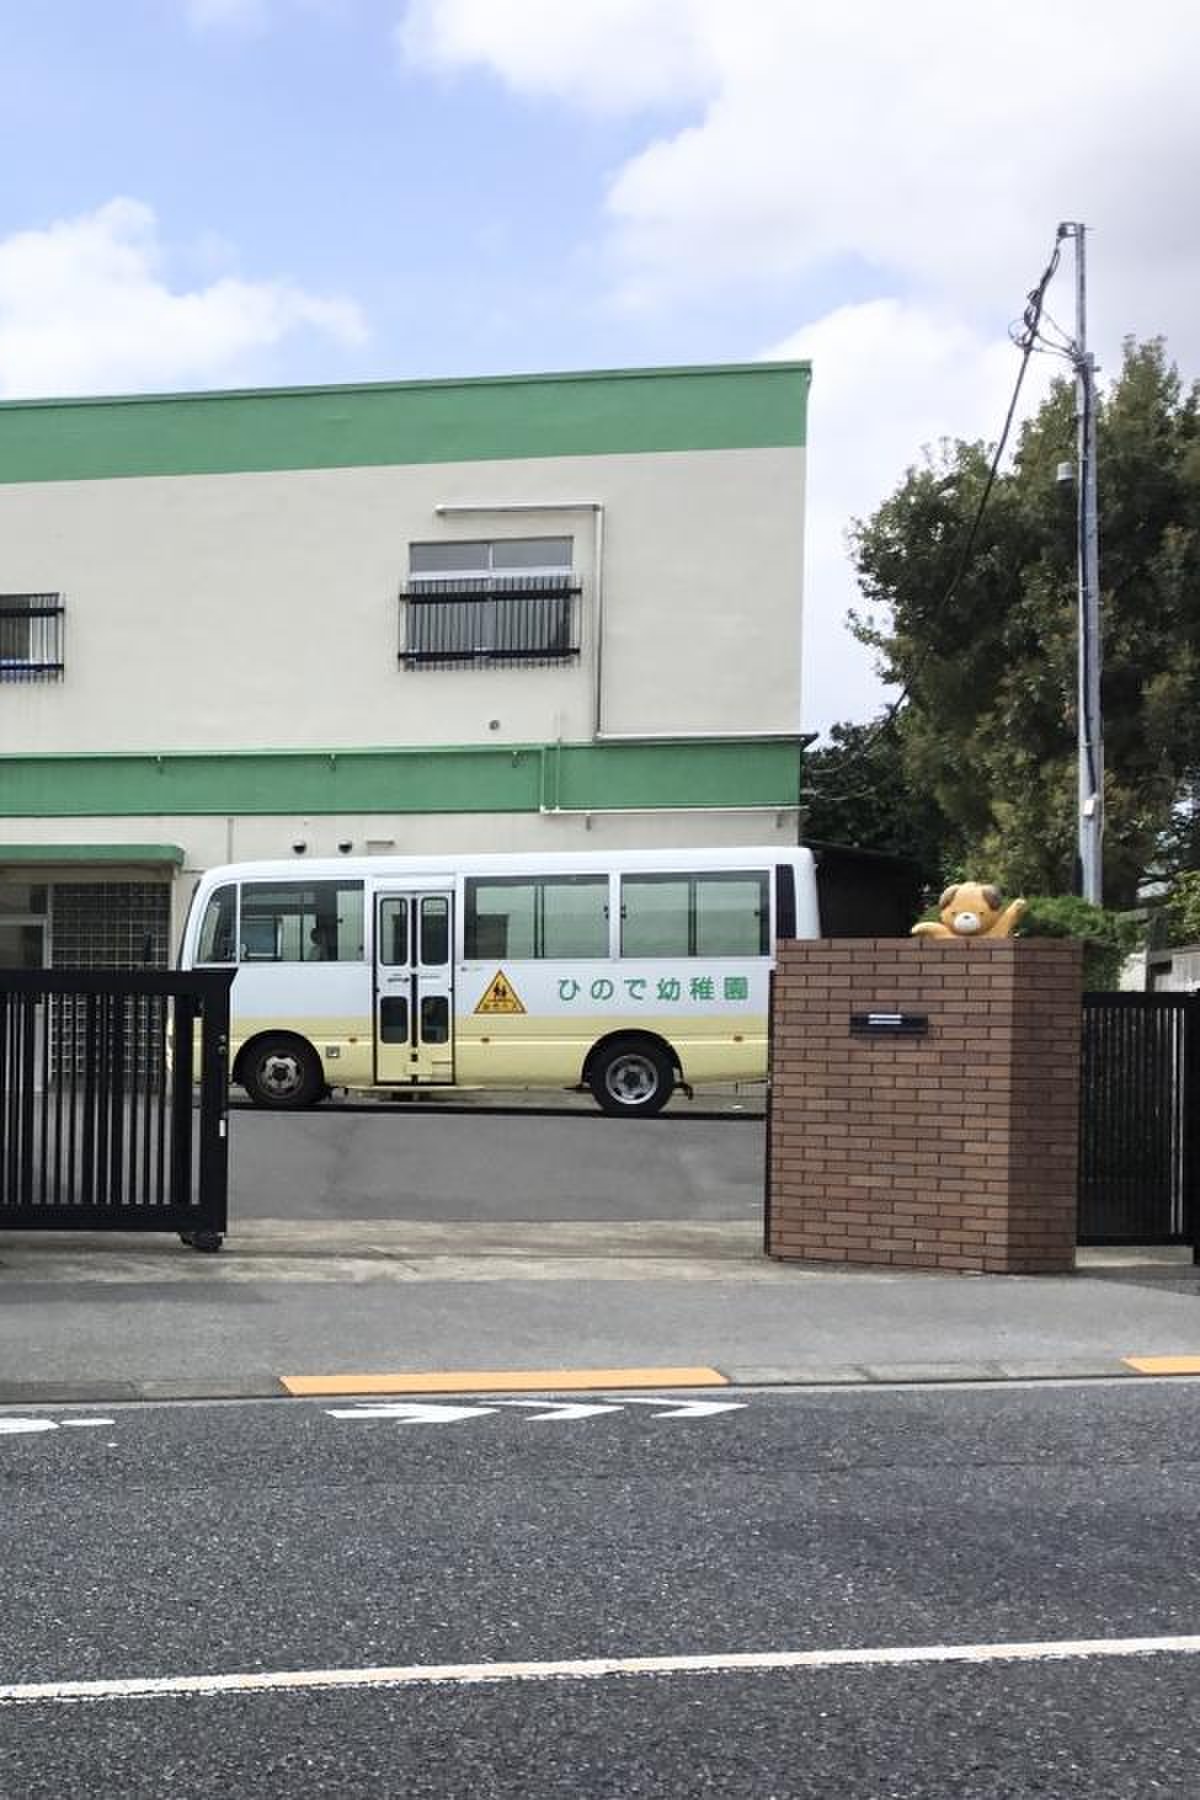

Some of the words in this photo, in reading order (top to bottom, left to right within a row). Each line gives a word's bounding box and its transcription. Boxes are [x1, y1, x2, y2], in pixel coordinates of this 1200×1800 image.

[558, 976, 749, 1001] ひので幼稚園
